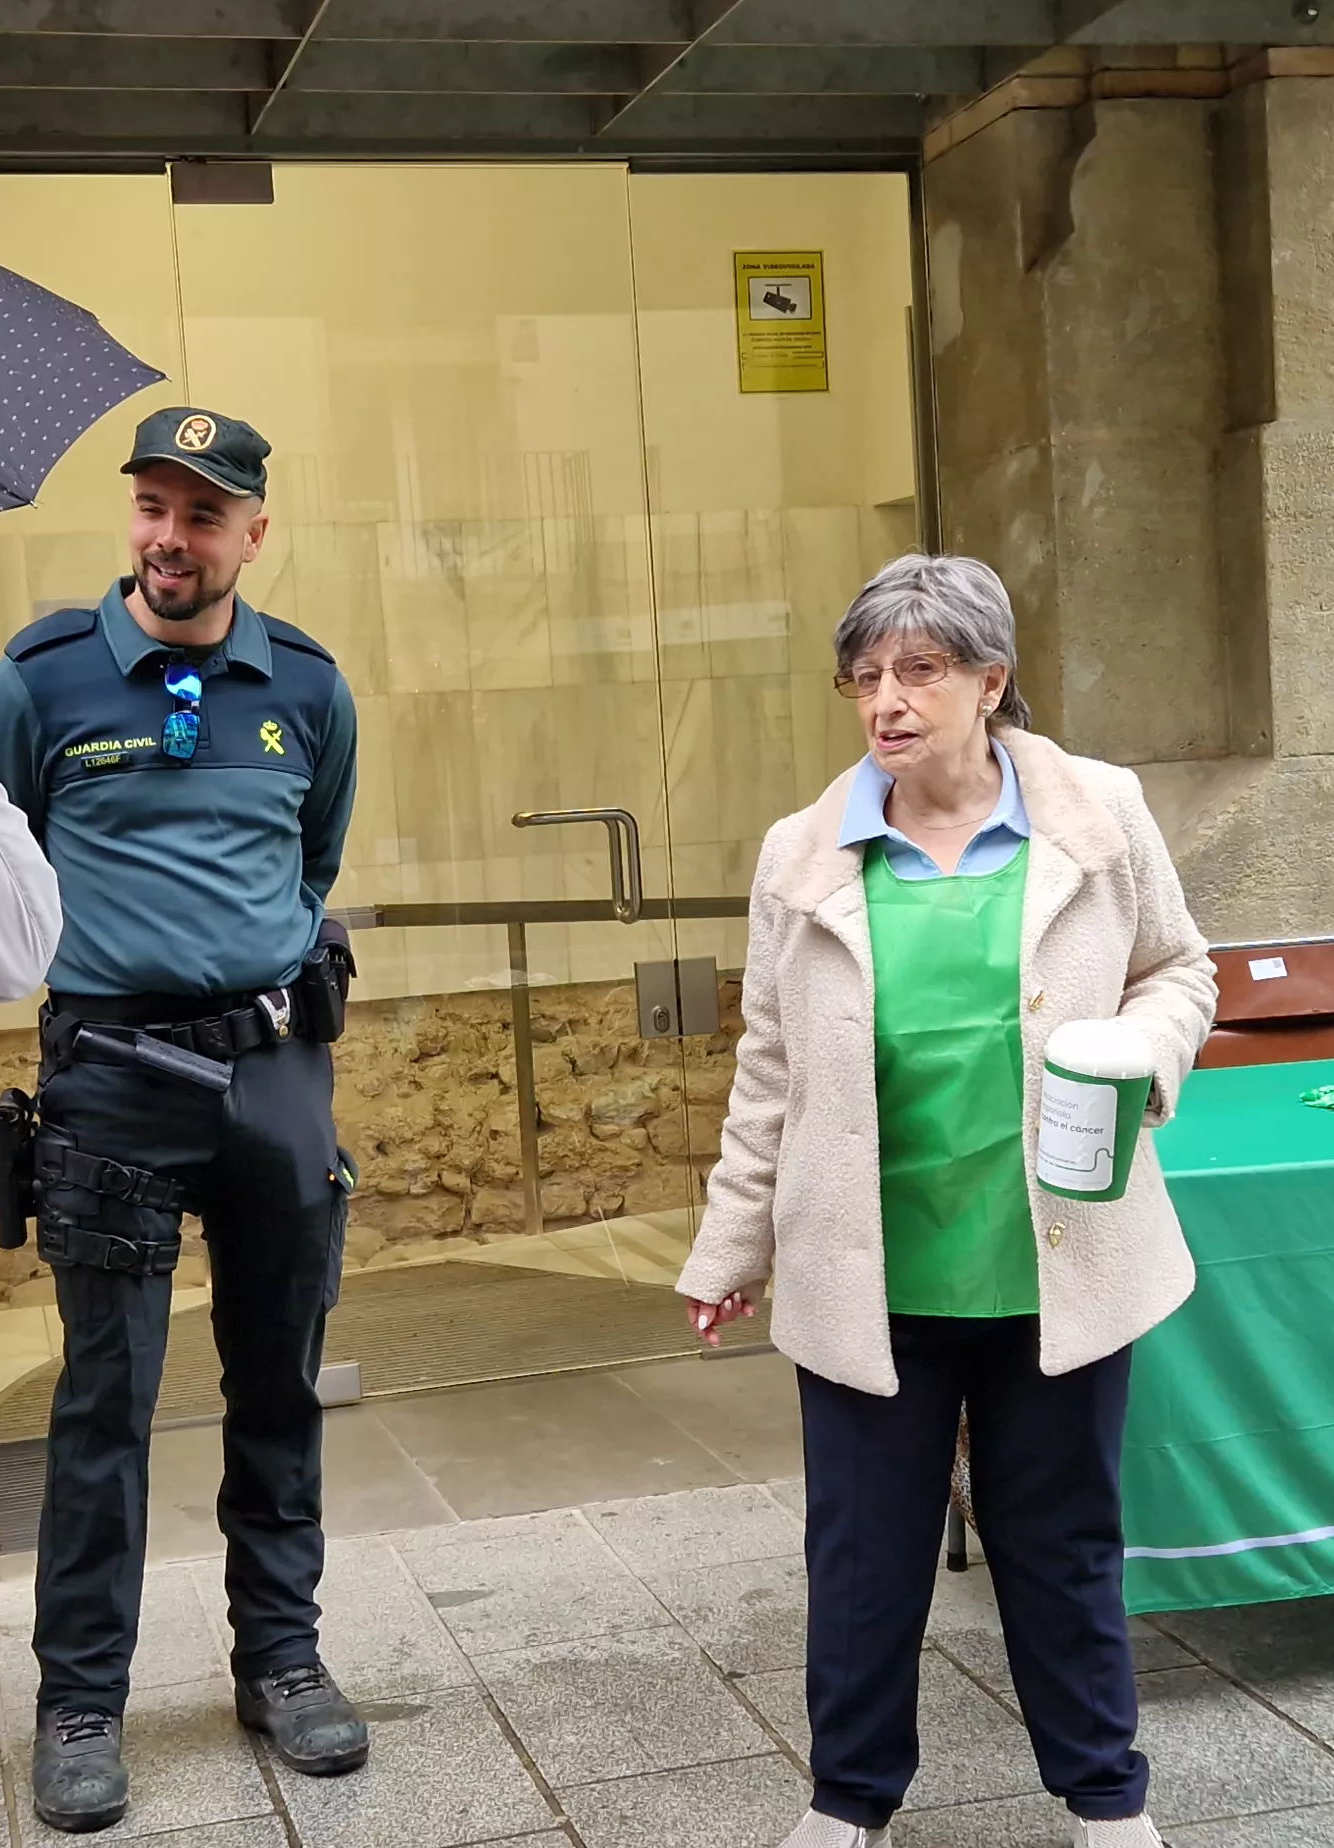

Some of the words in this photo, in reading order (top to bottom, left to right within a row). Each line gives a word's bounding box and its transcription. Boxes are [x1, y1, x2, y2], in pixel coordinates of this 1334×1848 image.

[64, 740, 122, 757] GUARDIA
[124, 737, 157, 748] CIVIL
[1060, 1122, 1068, 1131] el
[1069, 1123, 1105, 1135] cáncer
